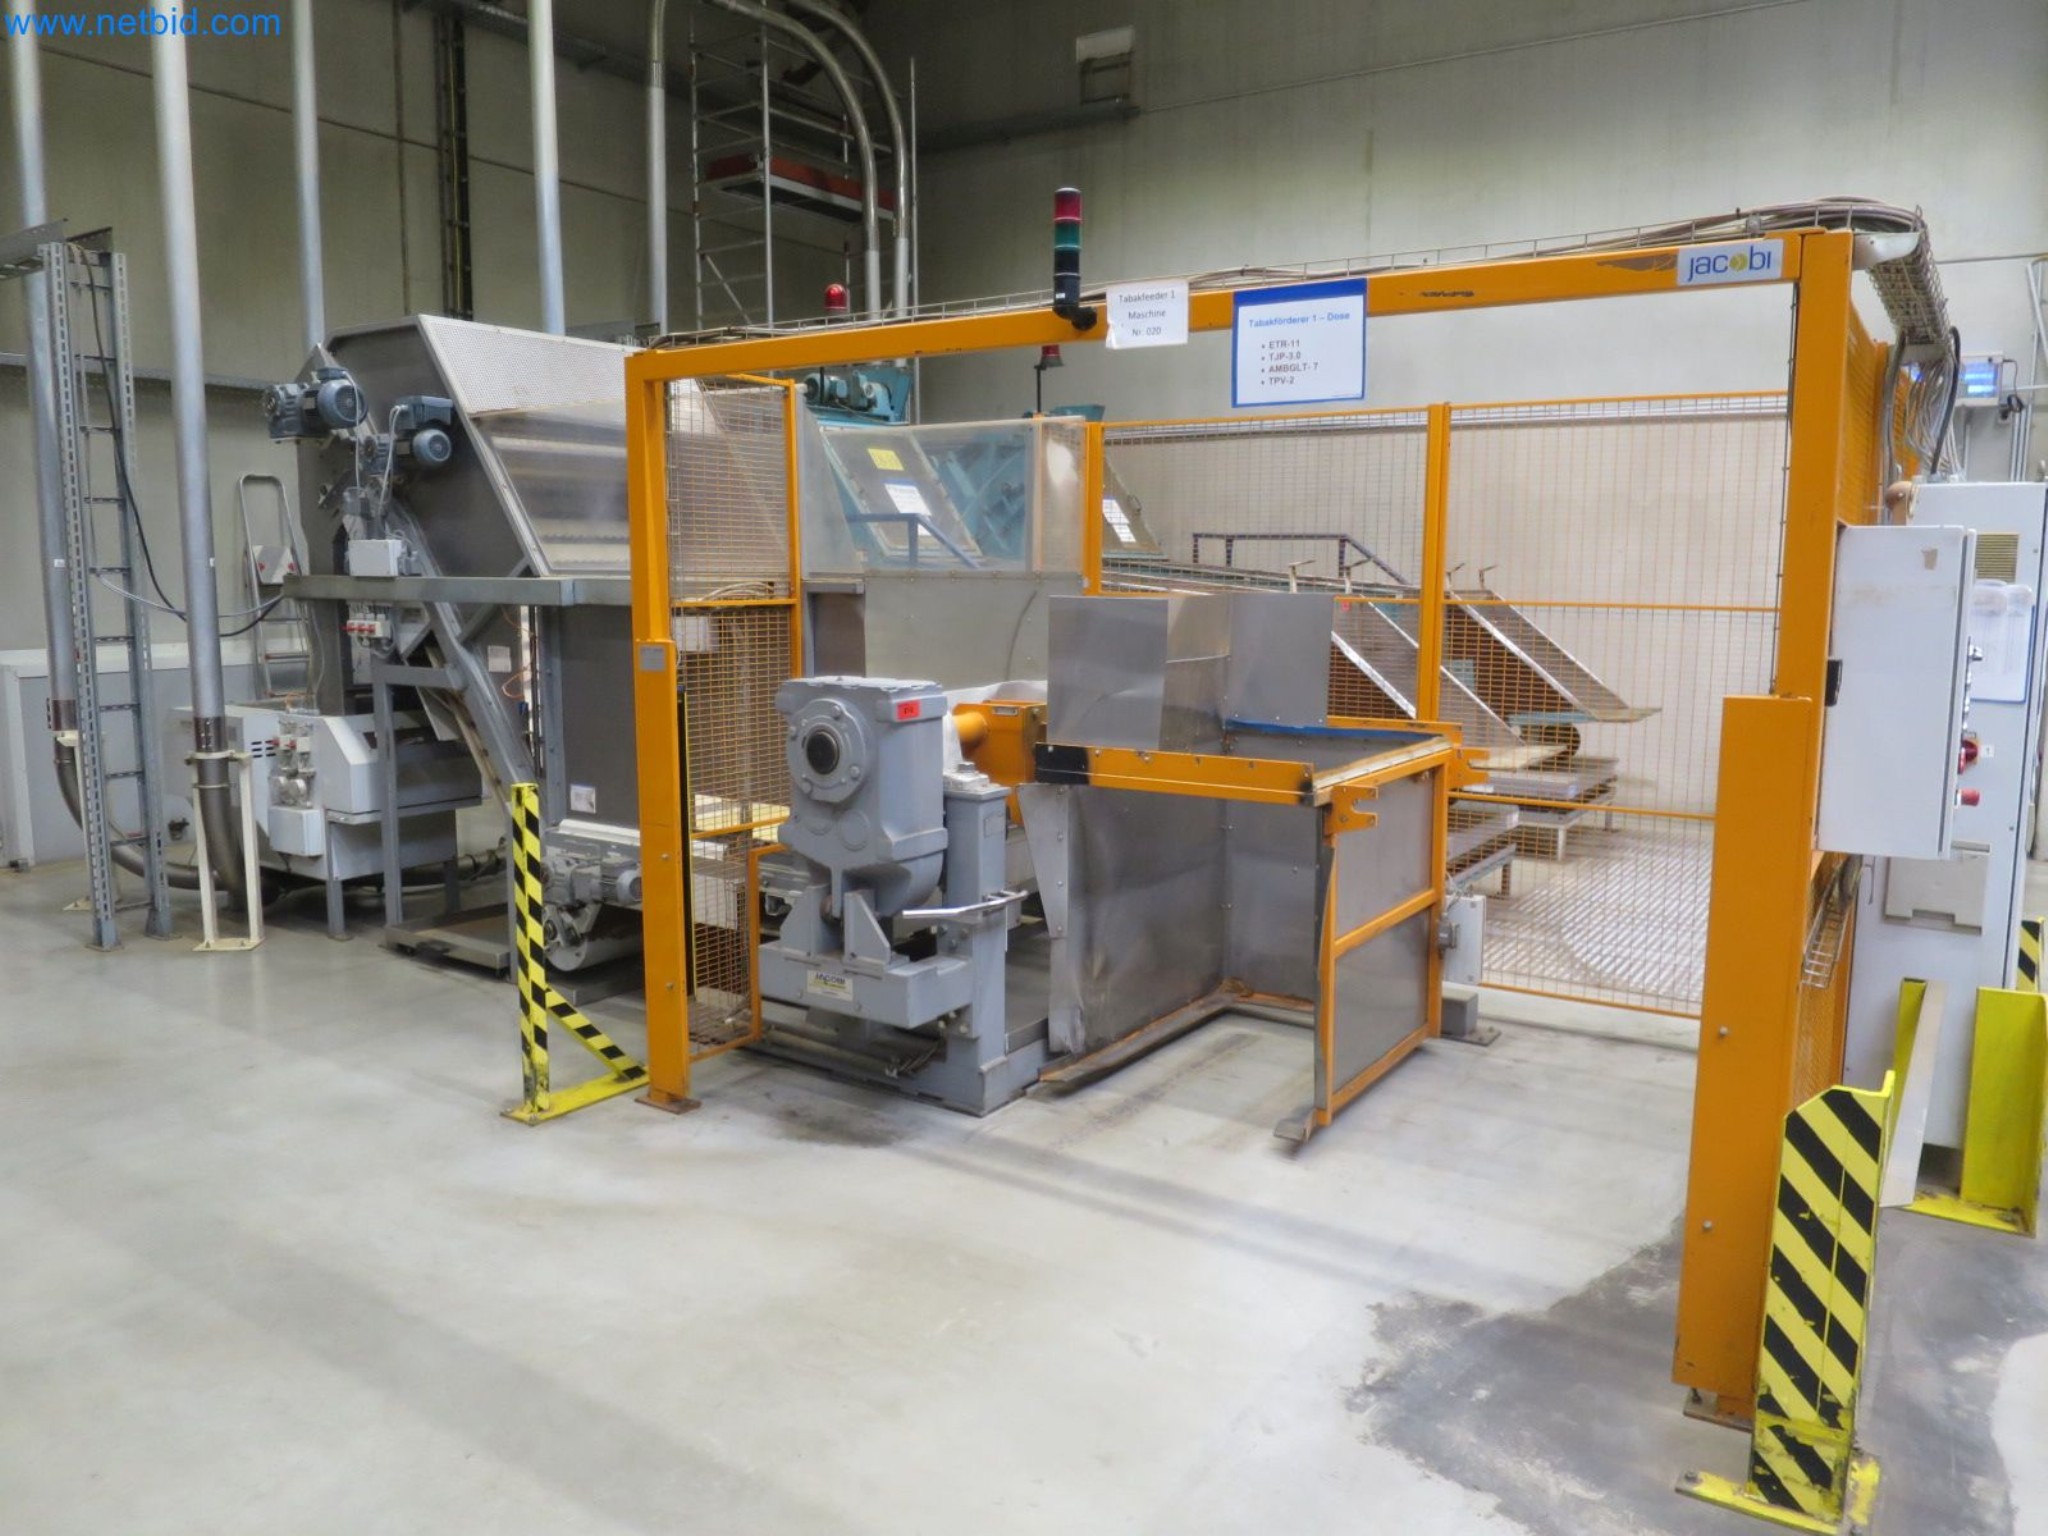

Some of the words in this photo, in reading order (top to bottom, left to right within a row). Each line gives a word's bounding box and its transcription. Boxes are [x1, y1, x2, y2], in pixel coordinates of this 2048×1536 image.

[1688, 245, 1772, 282] jacobi
[1119, 291, 1168, 304] Tabakfeeder
[1170, 289, 1176, 299] 1
[1128, 309, 1166, 320] Maschine
[1249, 315, 1310, 328] Tabakförderer
[1312, 313, 1317, 323] 1
[1327, 311, 1350, 321] Dose
[1146, 326, 1162, 337] 020
[1269, 339, 1300, 349] ETR-11
[1269, 376, 1295, 386] TPV-2
